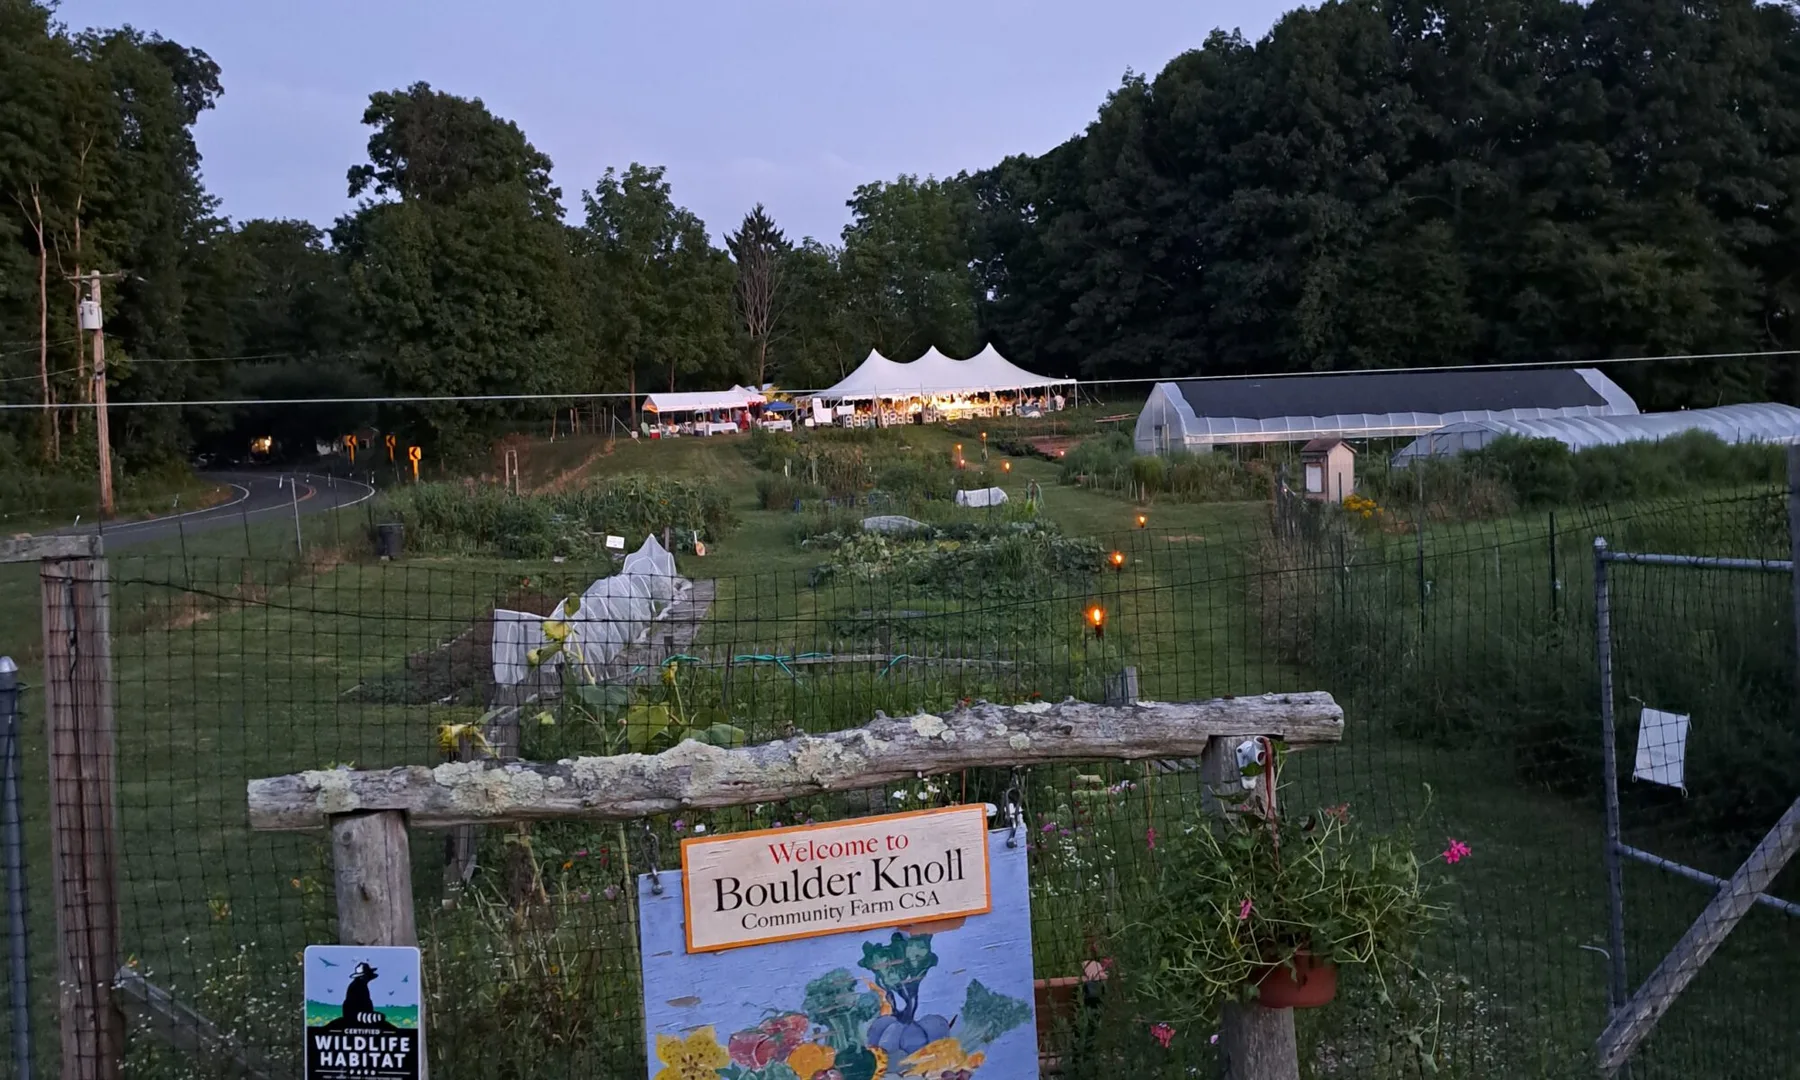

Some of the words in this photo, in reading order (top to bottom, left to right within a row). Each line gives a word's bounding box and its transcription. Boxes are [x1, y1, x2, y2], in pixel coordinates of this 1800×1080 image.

[768, 836, 878, 864] Welcome
[886, 834, 909, 851] to
[712, 865, 862, 912] Boulder
[871, 848, 966, 892] Knoll
[741, 903, 845, 930] Community
[850, 899, 894, 916] Farm
[899, 890, 941, 909] CSA
[314, 1035, 411, 1052] WILDLIFE
[320, 1051, 406, 1068] HABITAT
